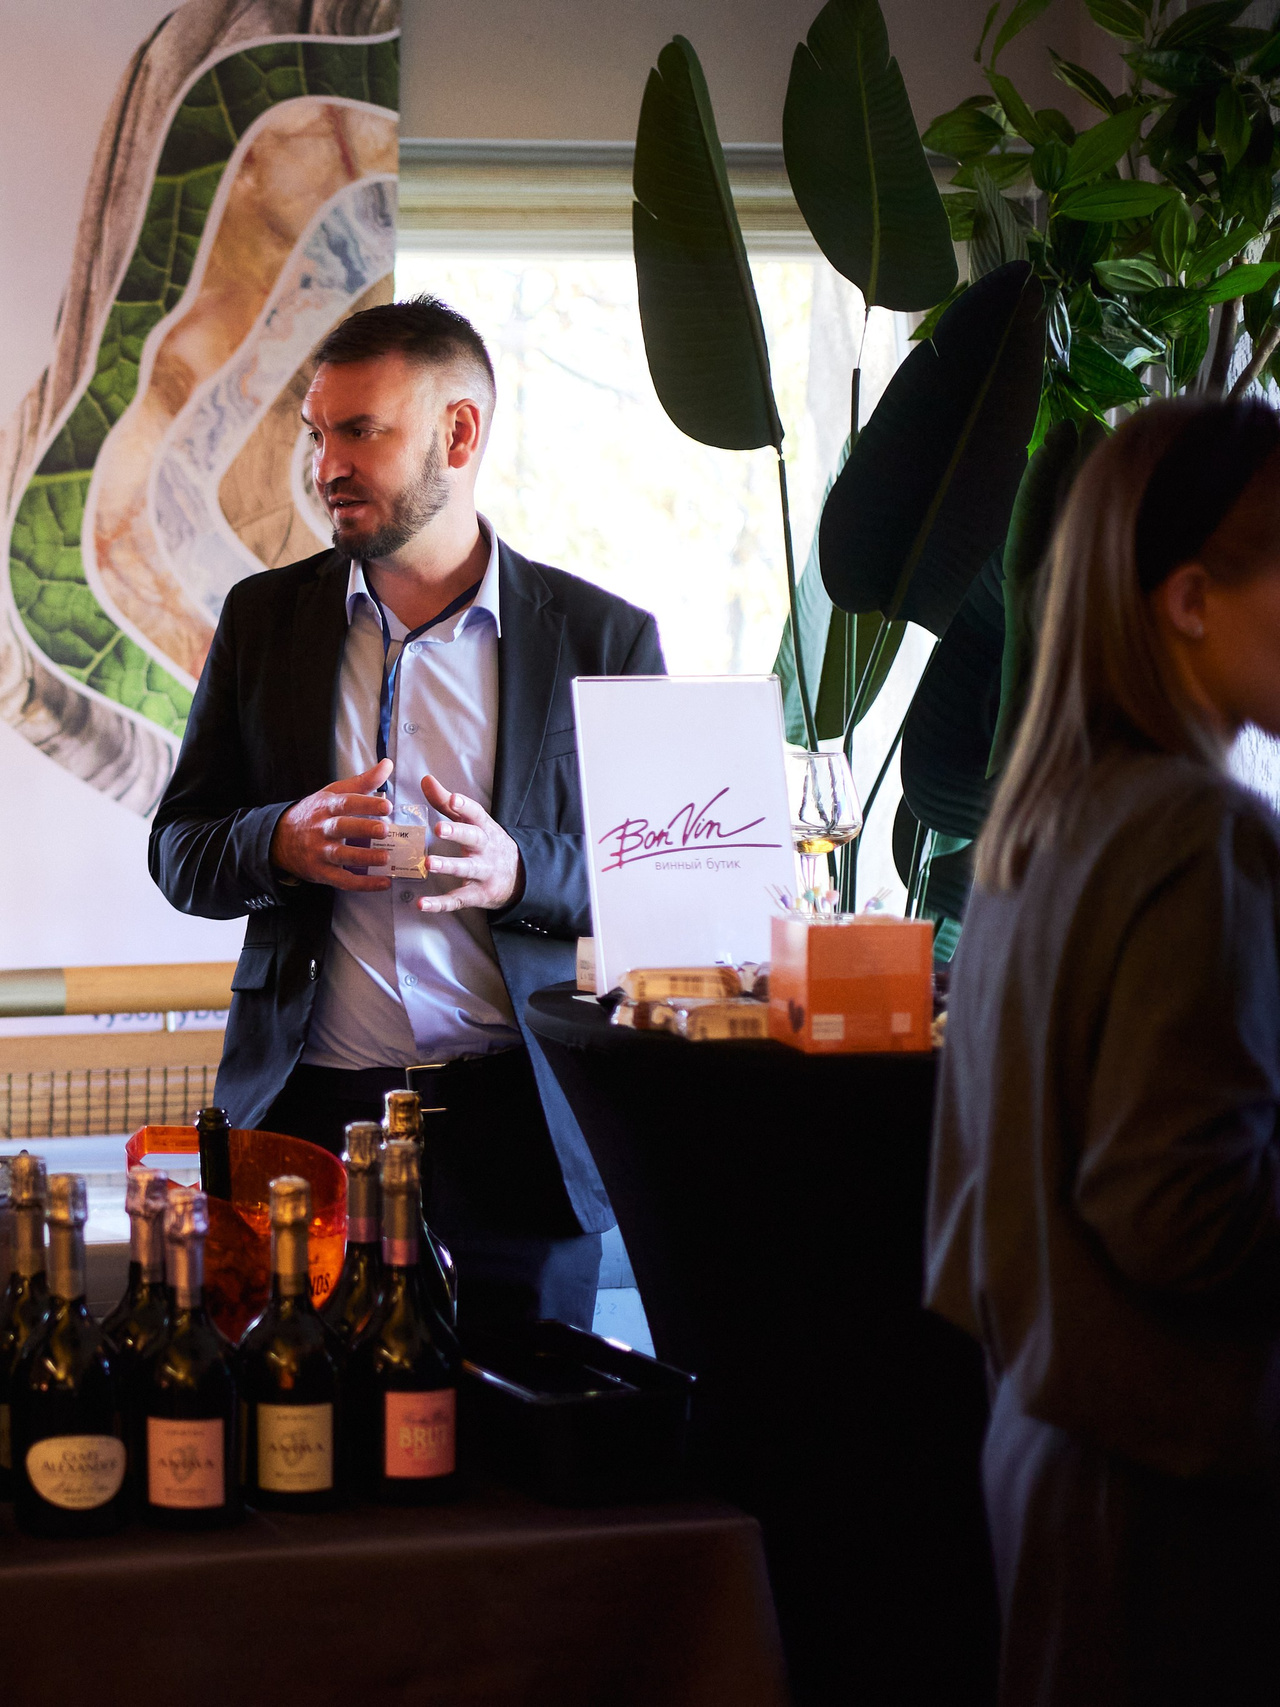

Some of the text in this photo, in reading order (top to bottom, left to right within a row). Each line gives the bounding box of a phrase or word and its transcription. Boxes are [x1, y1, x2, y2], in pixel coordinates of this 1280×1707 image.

[598, 786, 767, 869] Bon Vin
[655, 857, 741, 872] винный бутик
